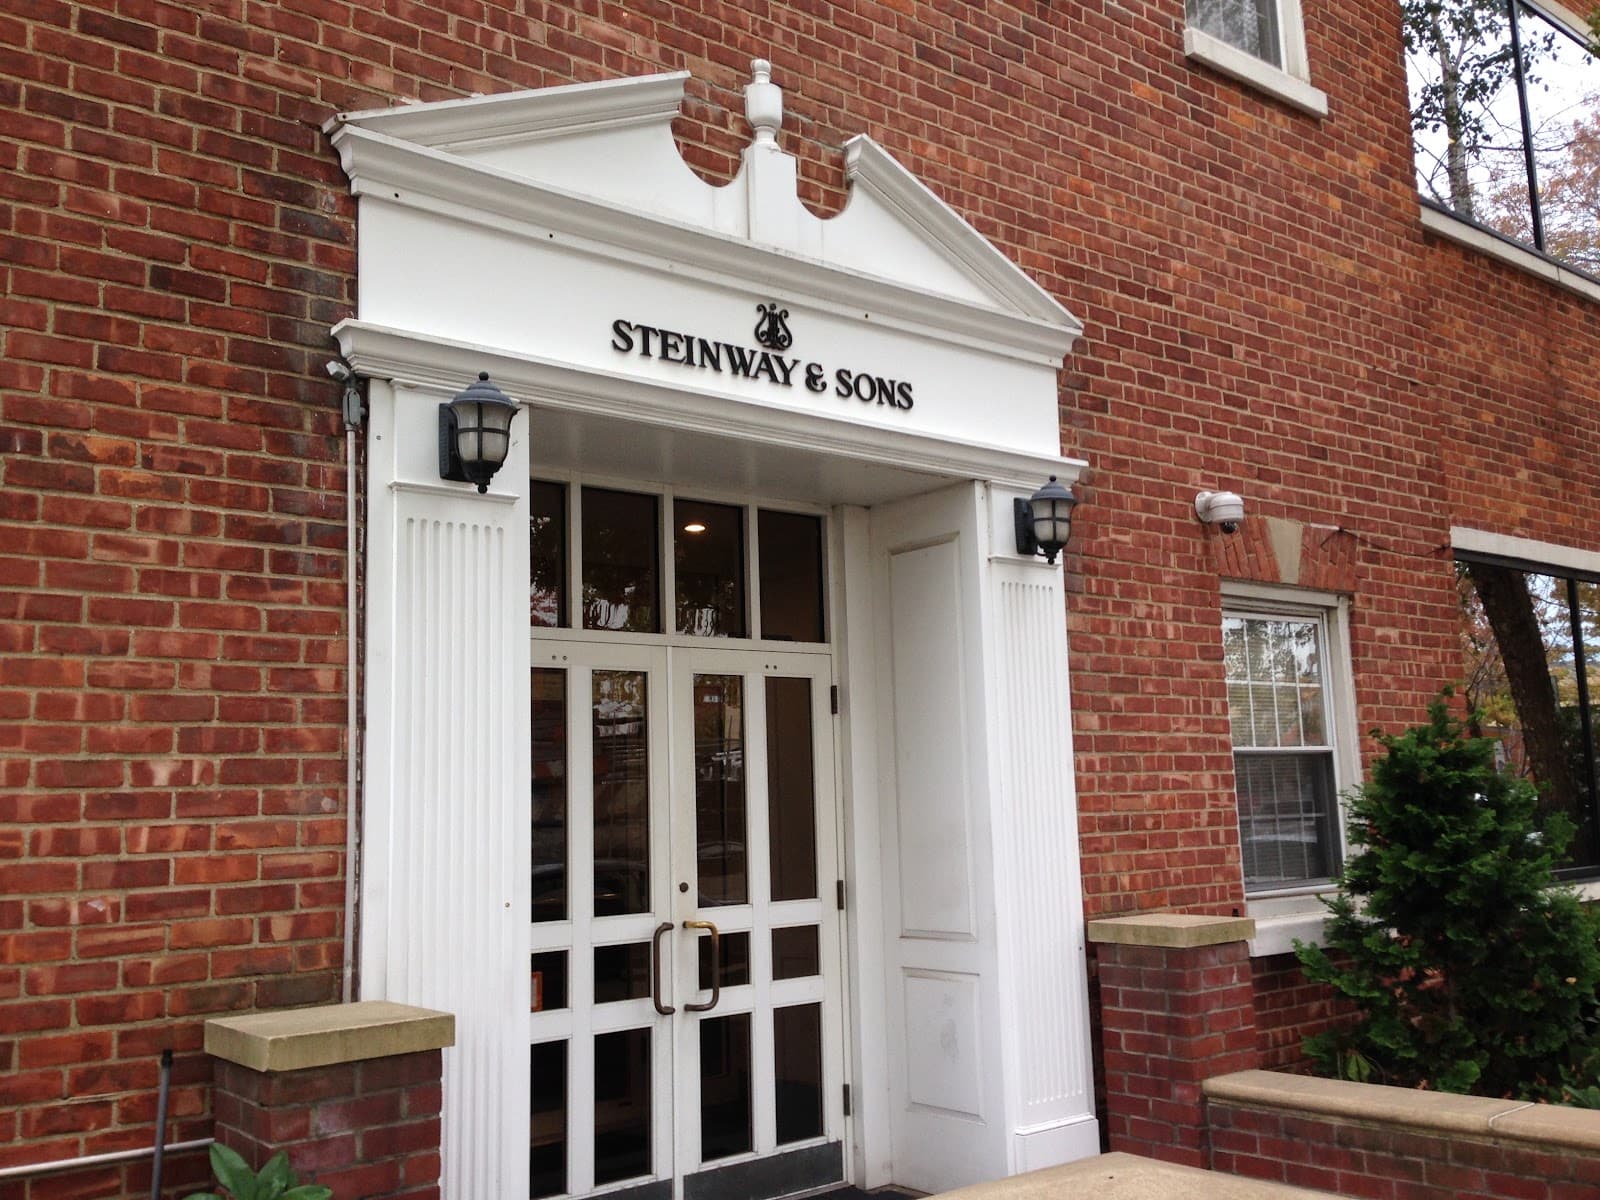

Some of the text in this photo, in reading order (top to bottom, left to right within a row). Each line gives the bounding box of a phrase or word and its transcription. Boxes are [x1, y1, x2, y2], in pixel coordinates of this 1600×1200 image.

[611, 319, 914, 411] STEINWAY & SONS
